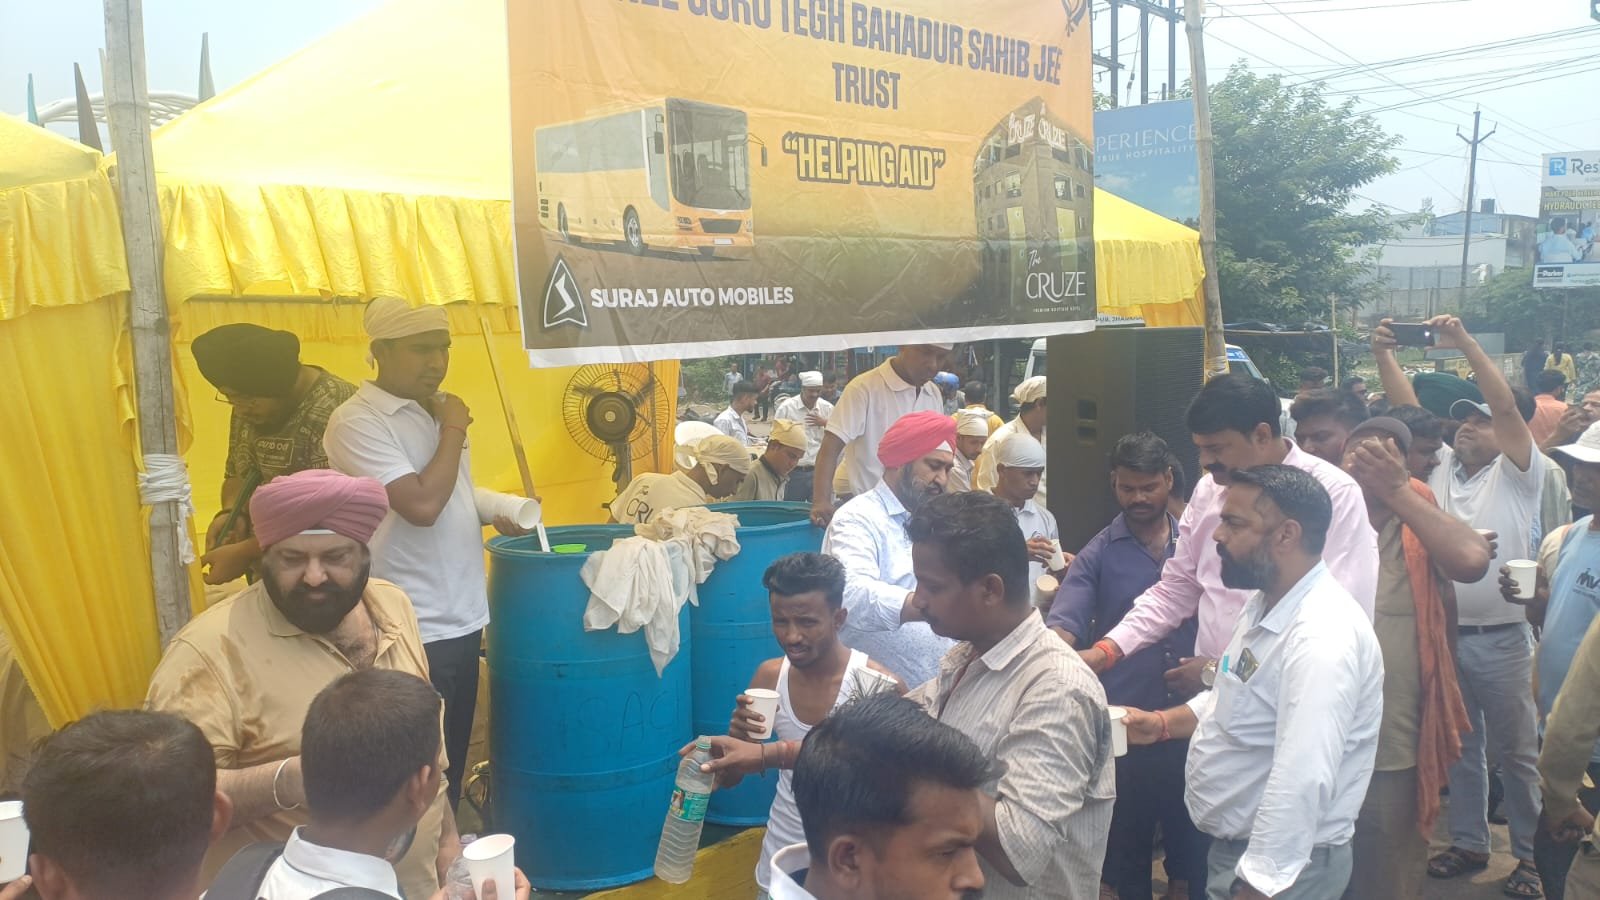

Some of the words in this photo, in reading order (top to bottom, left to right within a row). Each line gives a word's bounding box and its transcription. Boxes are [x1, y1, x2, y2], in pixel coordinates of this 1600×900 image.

[782, 0, 845, 43] TEGH
[852, 3, 963, 66] BAHADUR
[968, 28, 1030, 78] SAHIB
[1033, 44, 1063, 85] JEE
[832, 62, 900, 110] TRUST
[1126, 144, 1195, 159] HOSPITALITY
[1571, 158, 1600, 175] Res
[590, 288, 658, 308] SURAJ
[662, 287, 715, 307] AUTO
[718, 286, 794, 306] MOBILES
[1026, 271, 1086, 303] CRUZE
